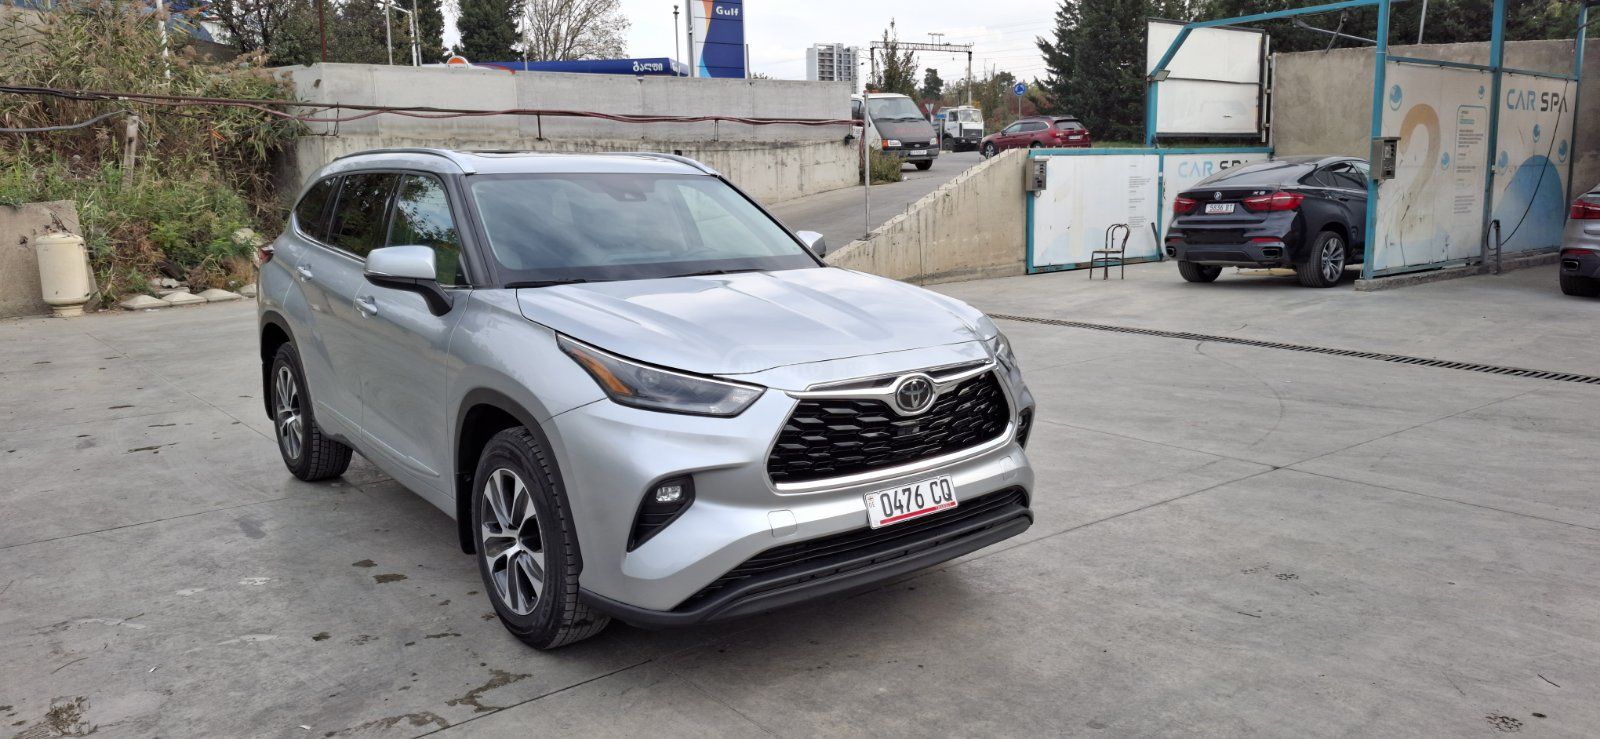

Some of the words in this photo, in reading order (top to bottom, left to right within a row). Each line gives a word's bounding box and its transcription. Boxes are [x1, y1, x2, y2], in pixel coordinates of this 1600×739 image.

[715, 5, 739, 16] Gulf
[1506, 88, 1536, 111] CAR
[1540, 91, 1568, 113] SPA
[1178, 160, 1214, 178] CAR
[880, 485, 925, 518] 0476
[929, 478, 953, 505] CQ
